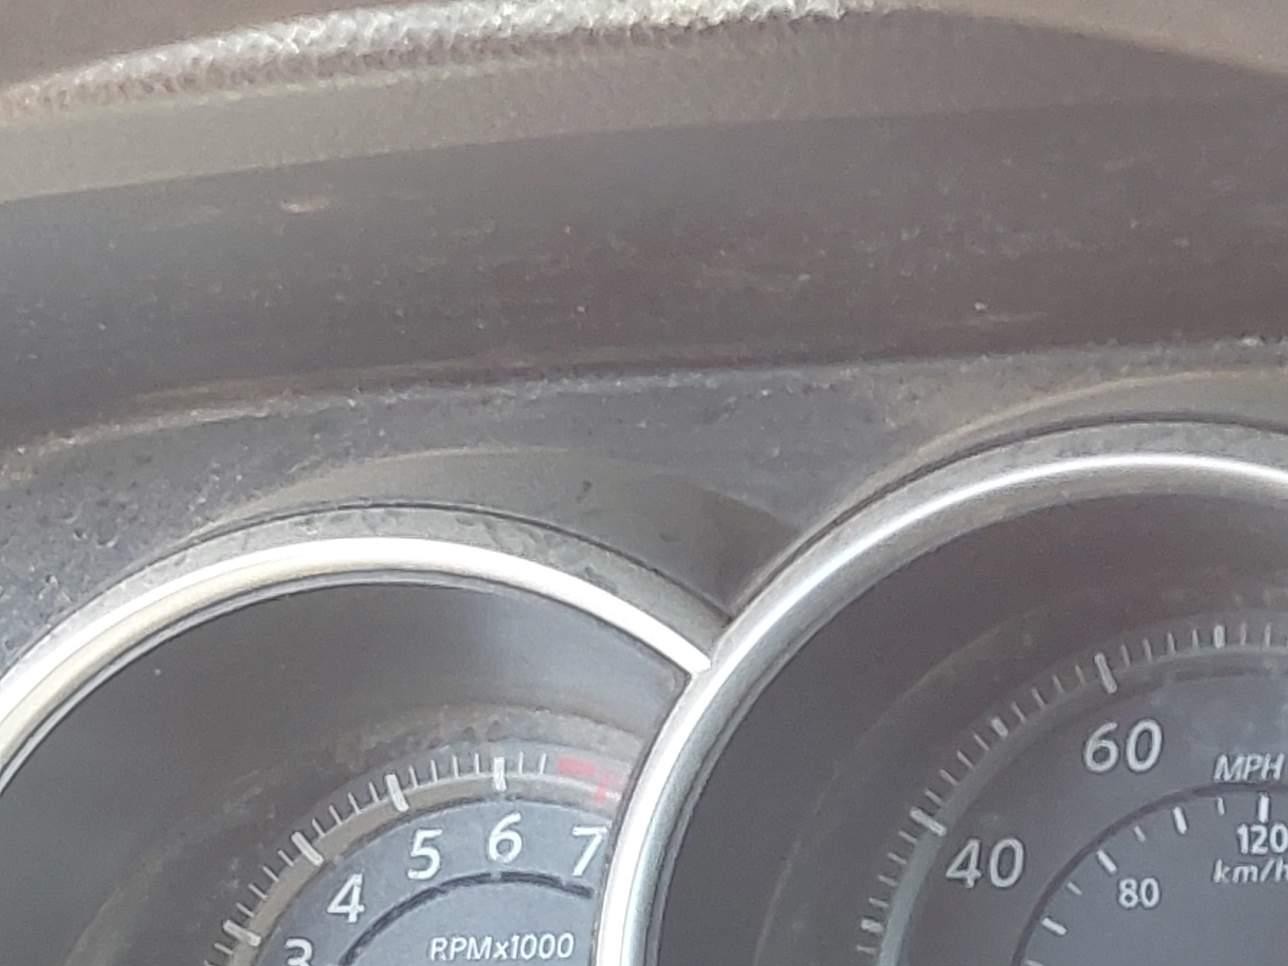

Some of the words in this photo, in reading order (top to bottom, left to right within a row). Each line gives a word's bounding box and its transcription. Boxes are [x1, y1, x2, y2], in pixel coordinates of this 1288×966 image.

[1082, 719, 1163, 773] 60
[1213, 754, 1284, 782] MPH
[407, 828, 443, 881] 5
[487, 812, 524, 863] 6
[572, 826, 607, 876] 7
[945, 838, 1025, 889] 40
[327, 873, 366, 923] 4
[1118, 878, 1160, 908] 80
[428, 932, 576, 962] RPMx1000
